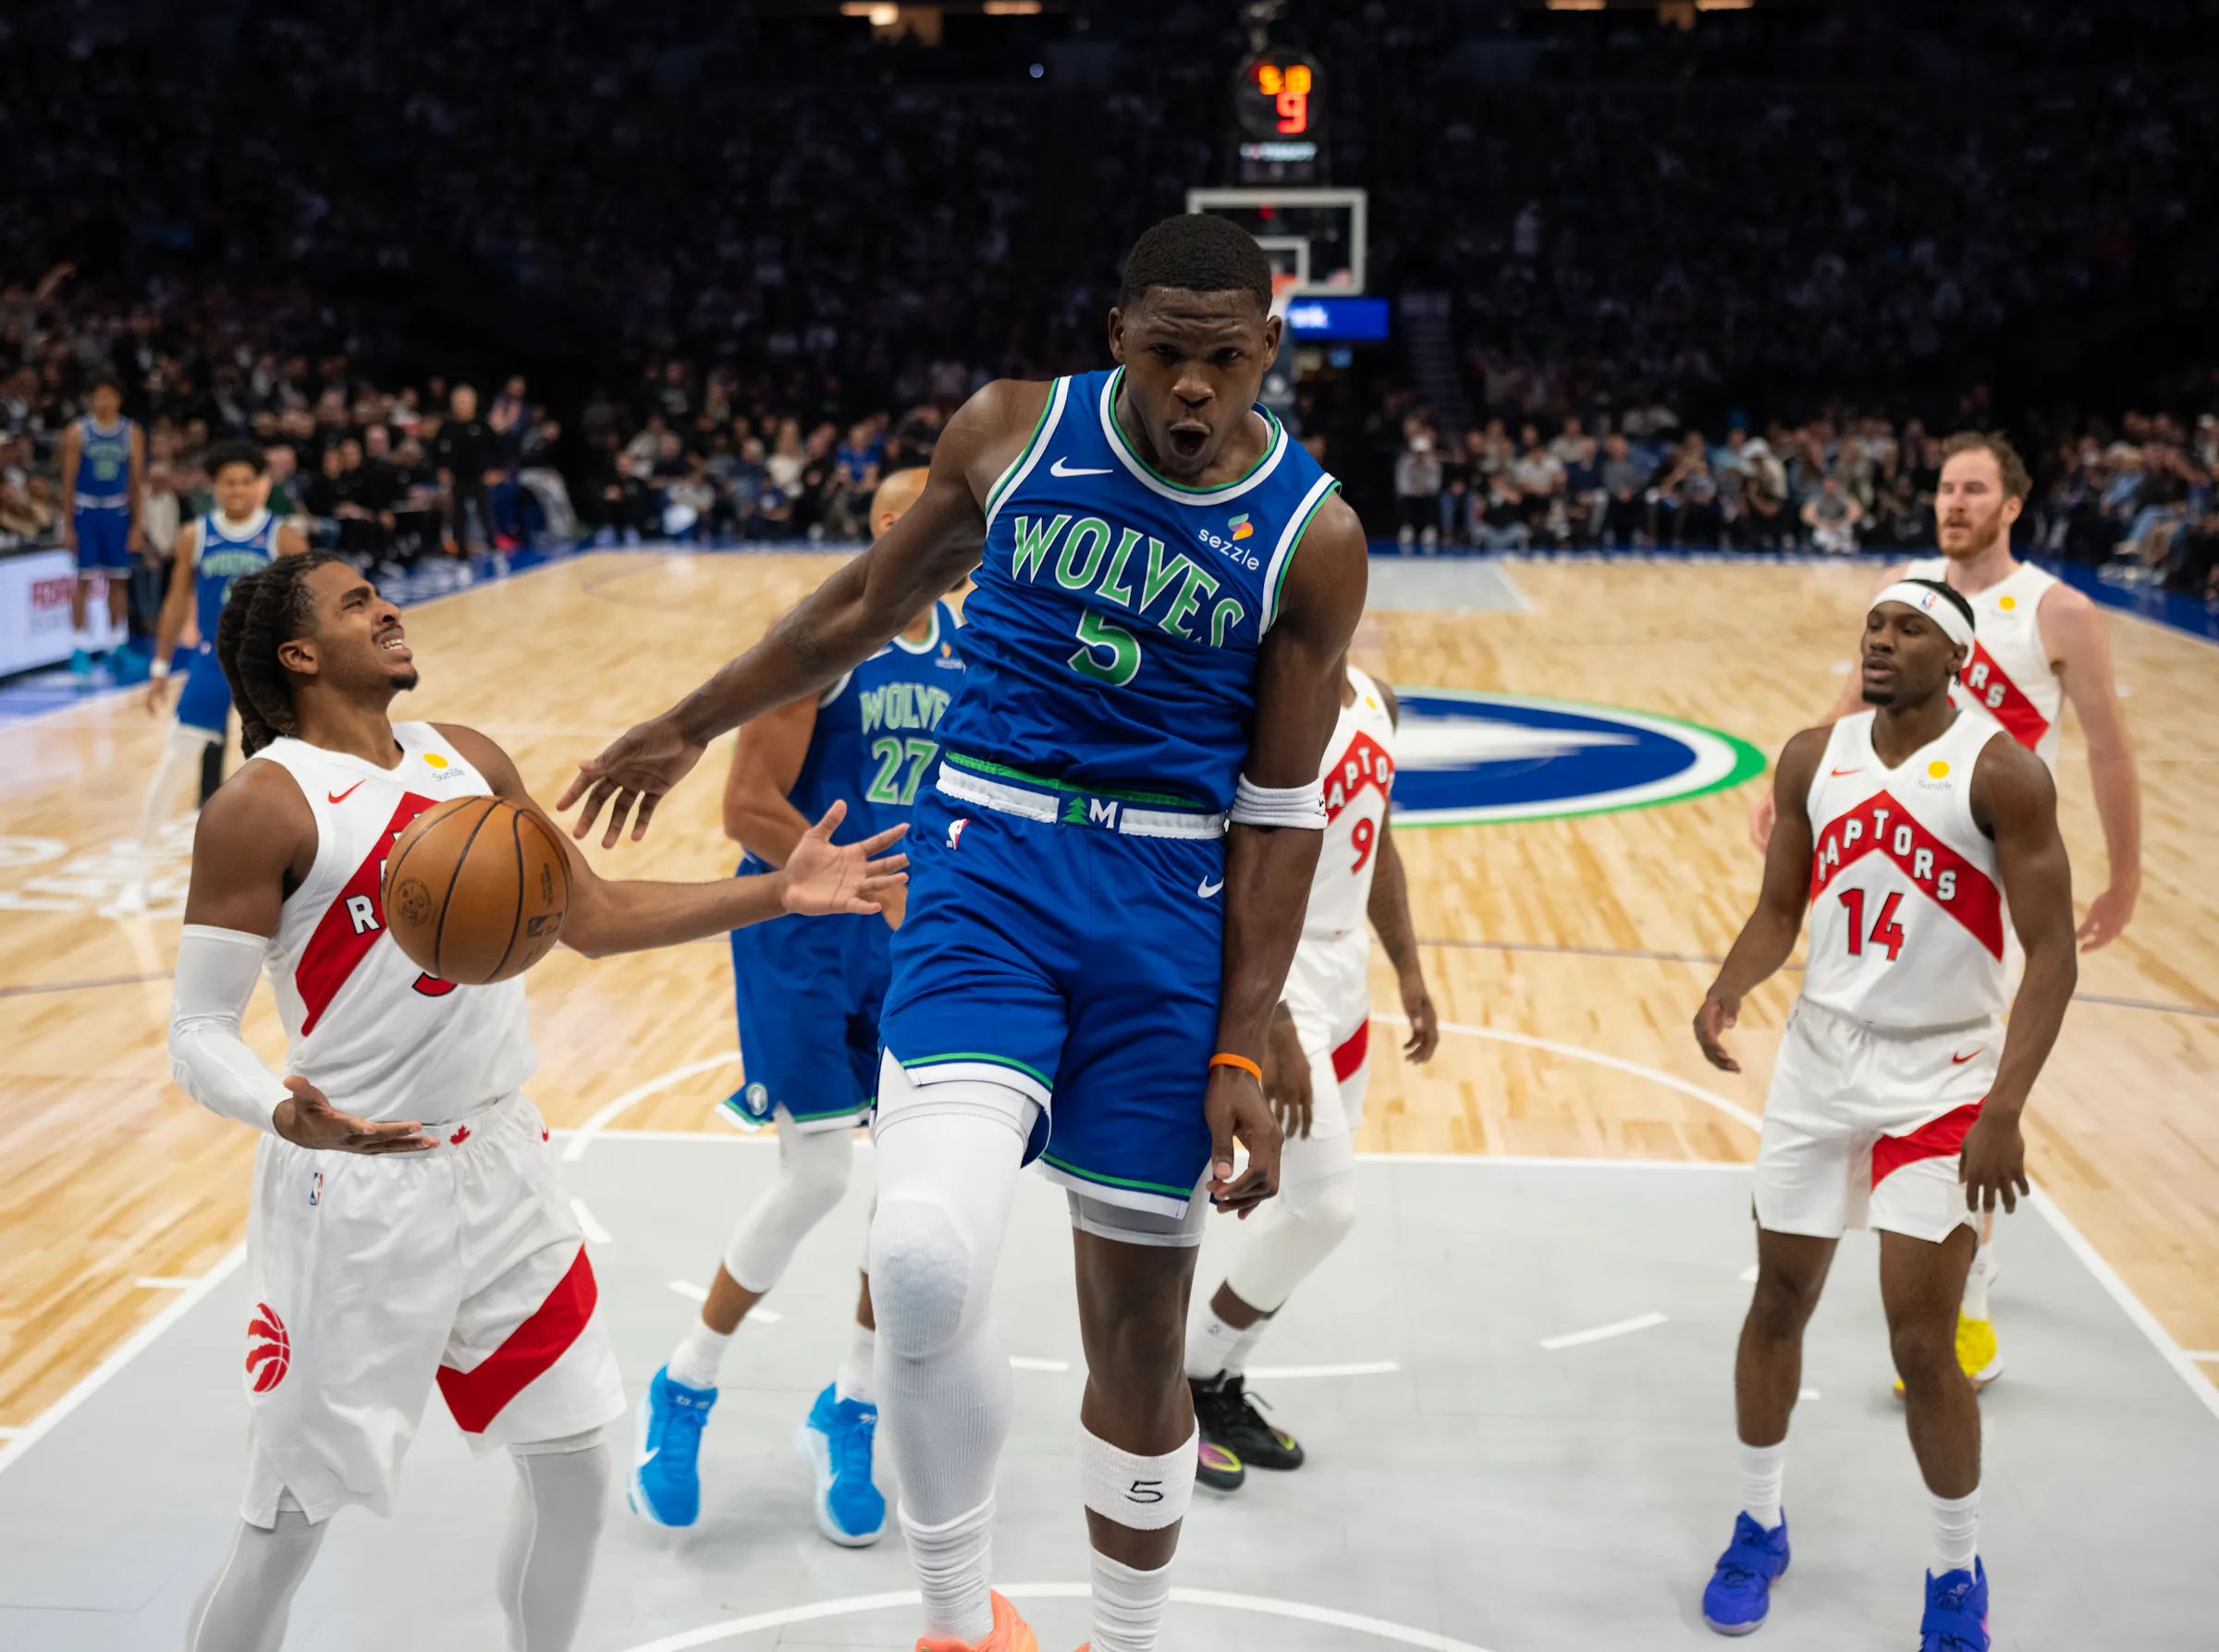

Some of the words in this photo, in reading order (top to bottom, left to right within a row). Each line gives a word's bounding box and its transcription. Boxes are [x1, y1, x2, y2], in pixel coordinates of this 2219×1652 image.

[1276, 92, 1307, 134] 9
[1198, 529, 1259, 570] sezzle
[1067, 606, 1142, 687] 5
[860, 681, 951, 736] WOLVE
[865, 737, 939, 806] 27
[1327, 747, 1394, 810] APTO
[1089, 798, 1119, 829] M
[1351, 817, 1374, 875] 9
[1838, 887, 1906, 962] 14
[1124, 1480, 1164, 1503] 5
